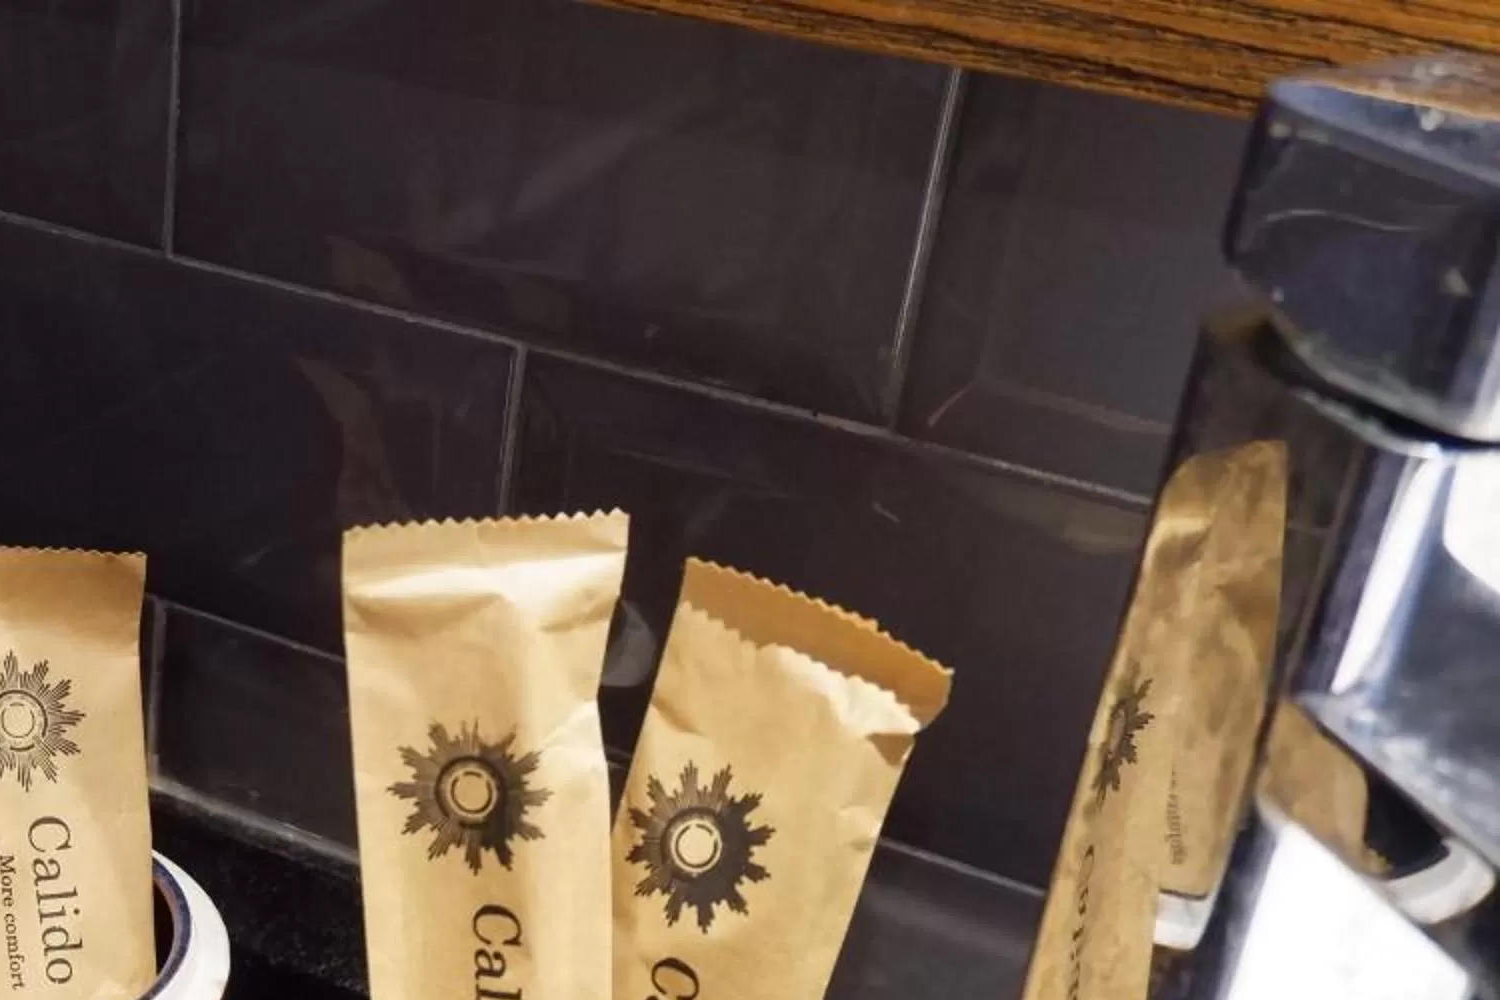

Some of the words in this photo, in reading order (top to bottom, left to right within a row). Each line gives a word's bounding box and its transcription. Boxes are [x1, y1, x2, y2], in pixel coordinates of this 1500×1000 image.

[0, 855, 16, 907] More
[27, 816, 83, 984] Calido
[4, 913, 25, 990] comfort
